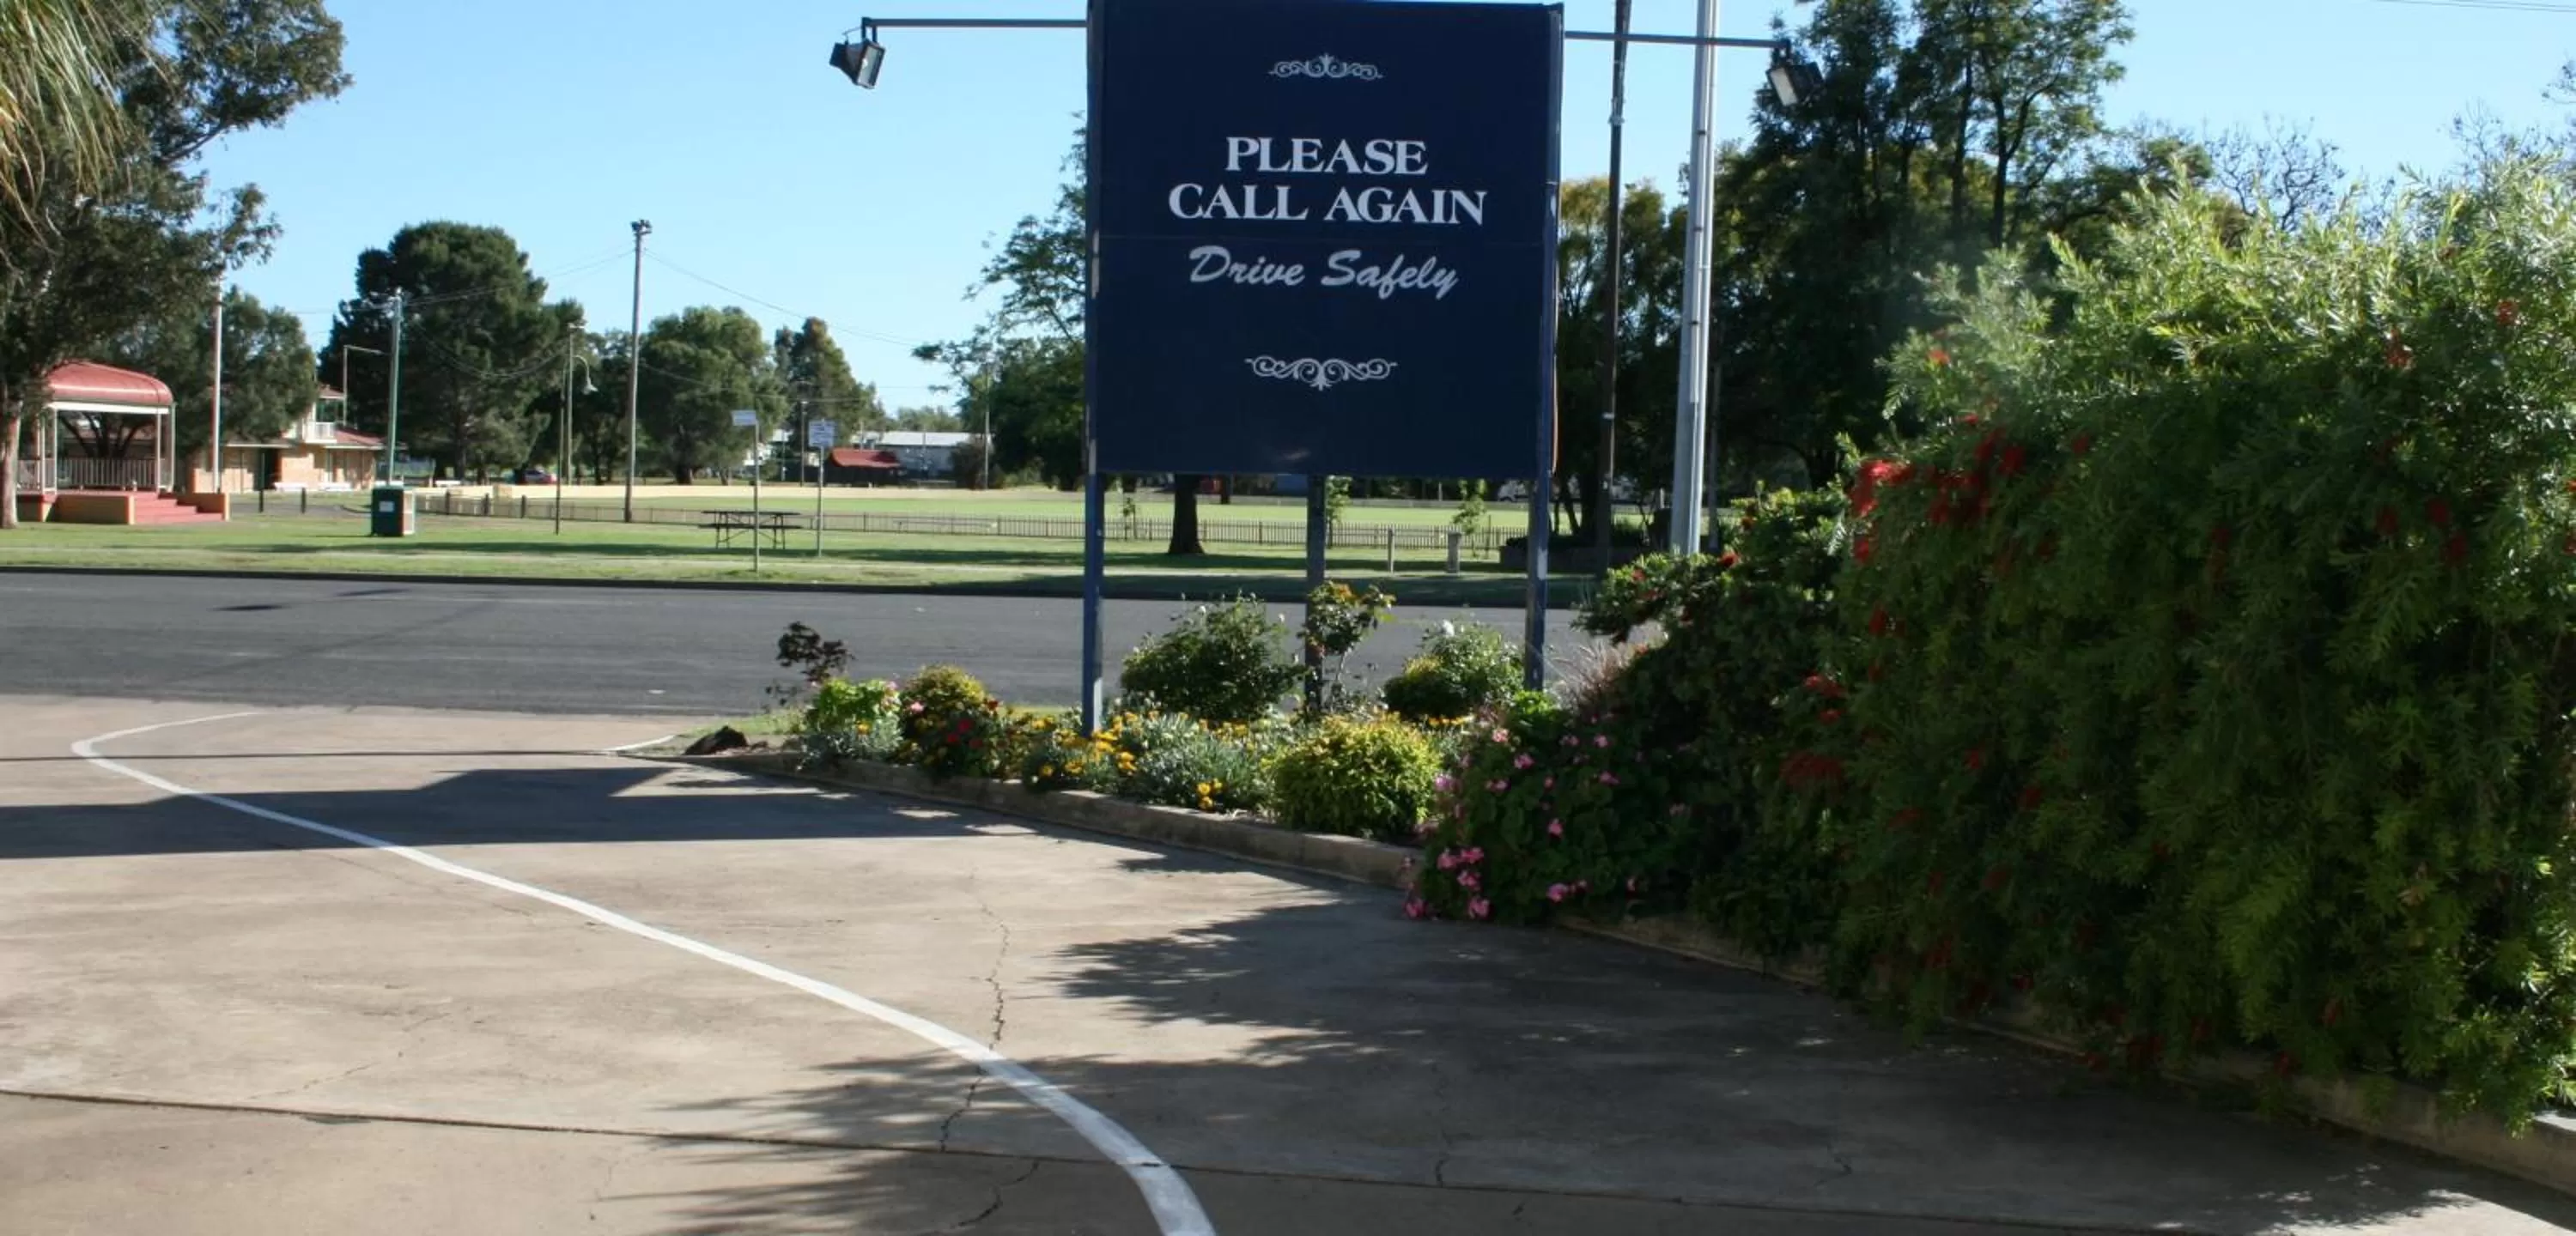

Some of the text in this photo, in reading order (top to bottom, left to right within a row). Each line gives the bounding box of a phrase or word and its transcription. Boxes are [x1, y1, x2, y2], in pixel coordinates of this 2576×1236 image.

[1225, 136, 1429, 175] PLEASE
[1169, 183, 1488, 225] CALL AGAIN
[1189, 245, 1459, 300] Drive Safely
